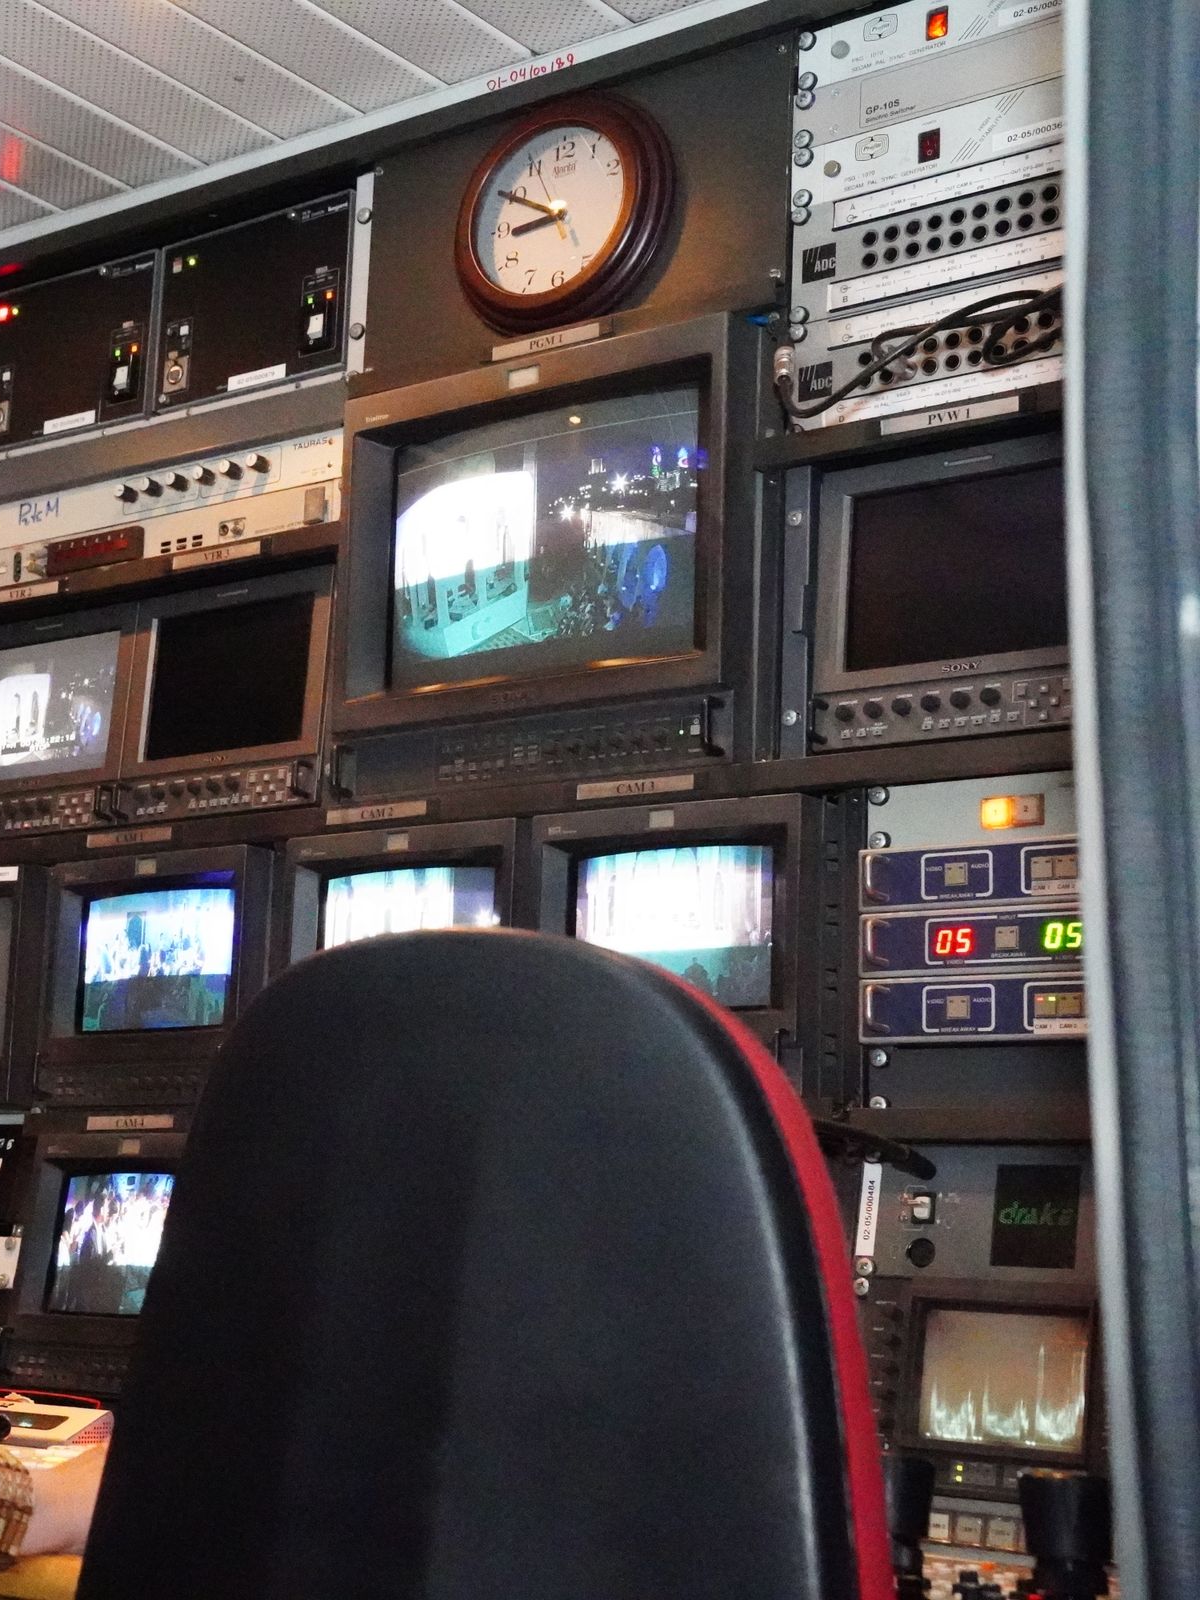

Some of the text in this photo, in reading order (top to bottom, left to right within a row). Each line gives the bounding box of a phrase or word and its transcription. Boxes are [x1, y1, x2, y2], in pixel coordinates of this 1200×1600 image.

[865, 98, 900, 116] GP-10S
[556, 141, 575, 162] 12
[590, 144, 596, 159] 1
[528, 160, 541, 177] 11
[607, 159, 620, 176] 2
[497, 222, 511, 239] 9
[505, 251, 519, 268] 8
[814, 256, 836, 273] ADC
[524, 269, 537, 285] 7
[551, 270, 565, 287] 6
[529, 336, 555, 350] PGM
[810, 377, 832, 392] ADC
[928, 408, 971, 425] PVW 1
[294, 437, 328, 450] TAURAS
[203, 550, 222, 561] VTR
[8, 588, 26, 599] VTR
[941, 661, 981, 673] SONY
[616, 780, 655, 794] CAM 3
[361, 806, 393, 820] CAM 2
[935, 927, 971, 954] 05
[1044, 921, 1083, 950] 05
[116, 1118, 138, 1128] CAM
[862, 1179, 876, 1241] 02-05/000484
[1000, 1201, 1074, 1226] drake
